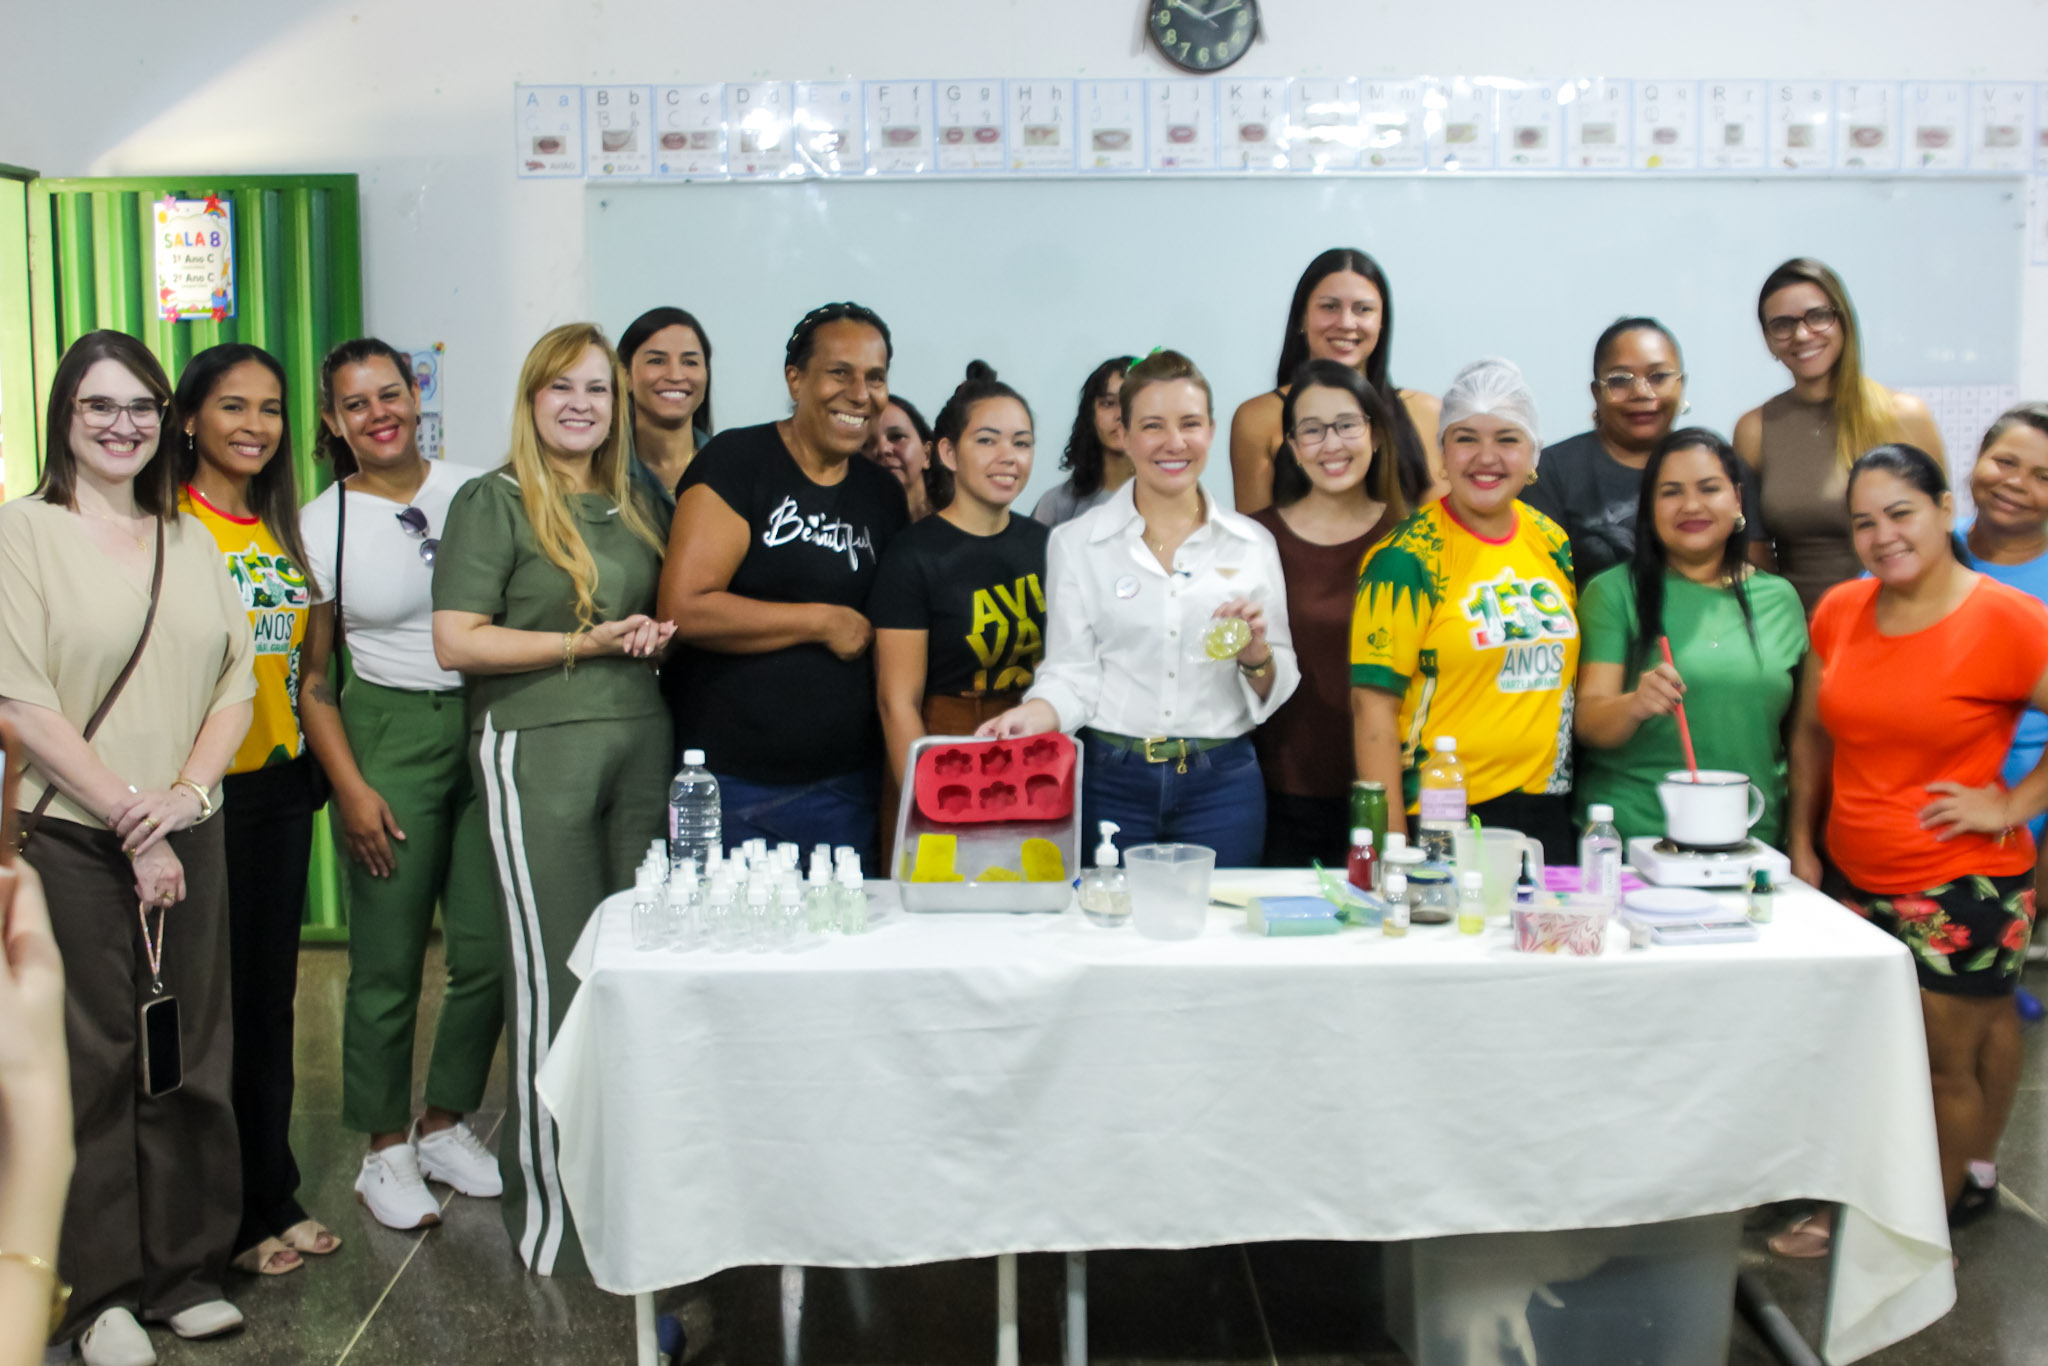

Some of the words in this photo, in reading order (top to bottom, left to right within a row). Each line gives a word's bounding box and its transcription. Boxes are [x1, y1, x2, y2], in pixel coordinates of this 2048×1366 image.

[1160, 10, 1171, 26] 9
[1166, 29, 1177, 45] 8
[1180, 42, 1192, 60] 7
[1199, 47, 1209, 64] 6
[526, 91, 540, 107] A
[559, 95, 569, 107] a
[597, 90, 610, 106] B
[629, 90, 640, 106] b
[666, 89, 680, 106] C
[699, 92, 710, 105] c
[736, 88, 750, 104] D
[878, 86, 890, 102] F
[912, 86, 920, 101] f
[946, 85, 961, 102] G
[980, 87, 990, 102] g
[1018, 86, 1032, 101] H
[1051, 85, 1062, 101] h
[1161, 84, 1171, 101] J
[1230, 84, 1243, 100] K
[1262, 85, 1272, 100] k
[1301, 85, 1311, 101] L
[1369, 85, 1384, 100] M
[1473, 88, 1483, 101] n
[1713, 85, 1726, 101] R
[1781, 85, 1793, 102] S
[164, 231, 206, 248] SALA
[185, 254, 205, 264] Ano
[206, 253, 216, 264] C
[186, 273, 205, 283] Ano
[207, 272, 216, 283] C
[1501, 643, 1564, 676] ANOS
